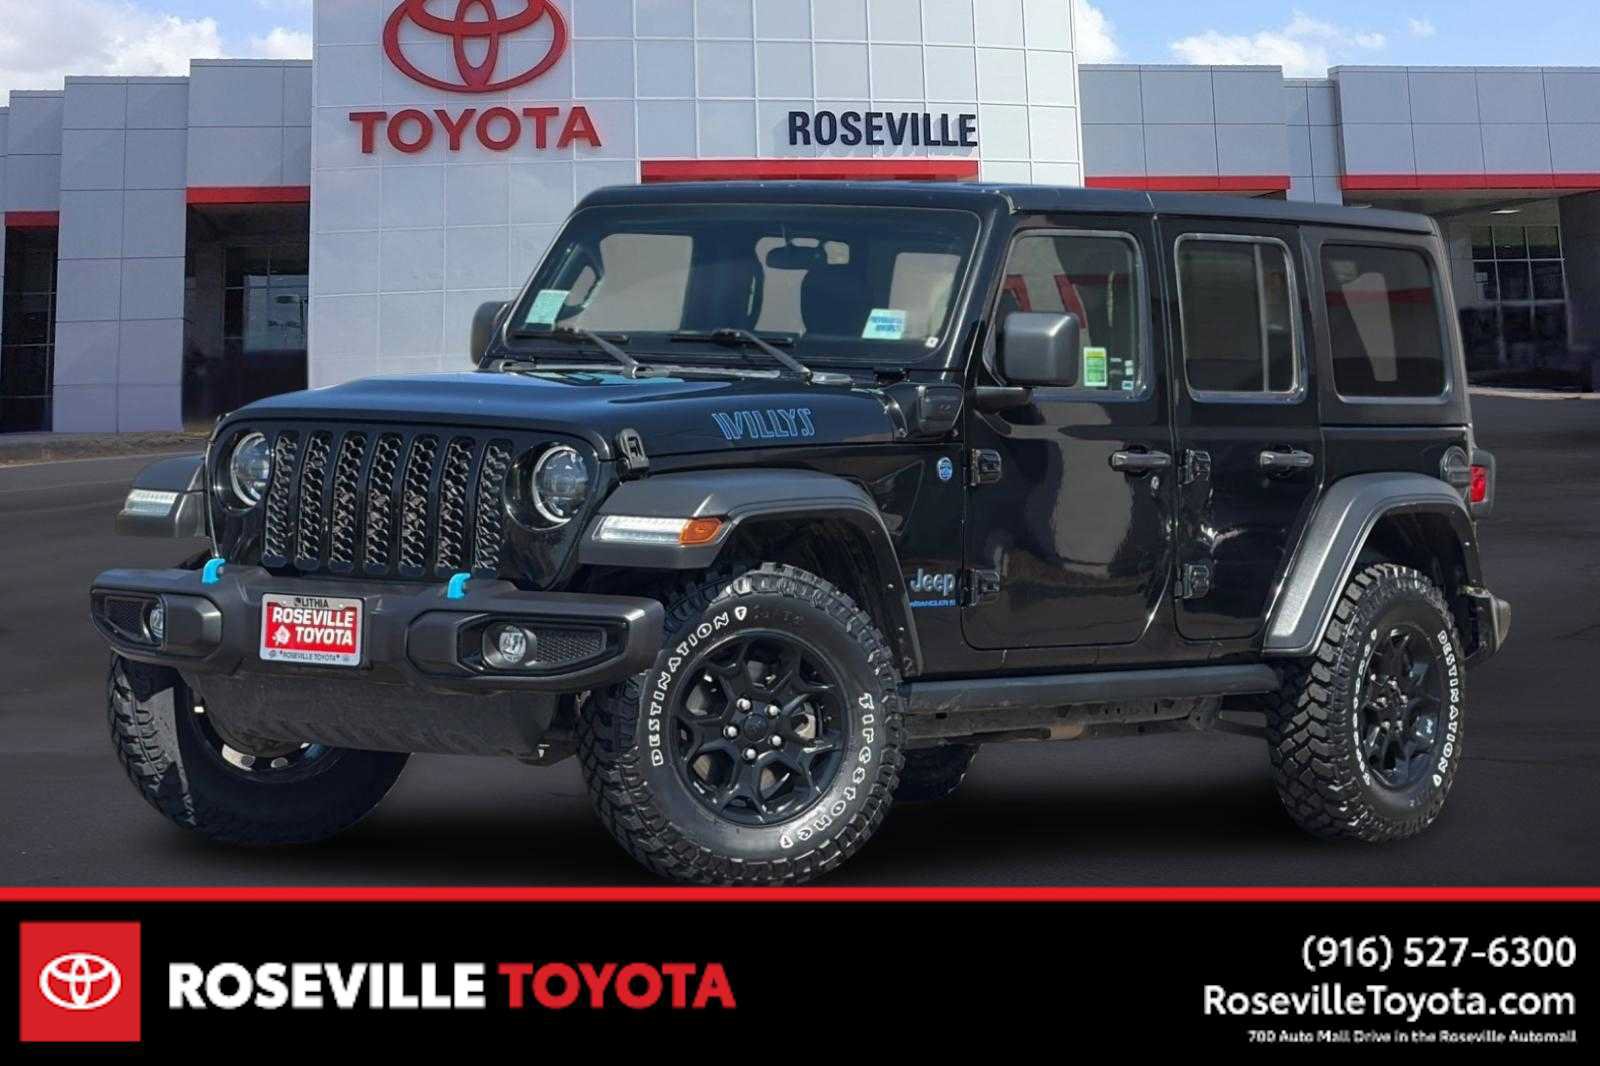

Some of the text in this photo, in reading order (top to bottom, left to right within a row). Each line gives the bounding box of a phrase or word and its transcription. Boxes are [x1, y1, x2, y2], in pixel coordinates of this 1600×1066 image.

[350, 106, 602, 154] TOYOTA
[788, 111, 978, 147] ROSEVILLE
[712, 408, 815, 440] WILLYS
[910, 568, 956, 597] Jeep
[272, 606, 354, 627] ROSEVILLE
[302, 597, 329, 608] LITHIA
[295, 627, 353, 646] TOYOTA
[648, 611, 730, 767] DESTINATION
[1437, 630, 1459, 773] DESTINATION
